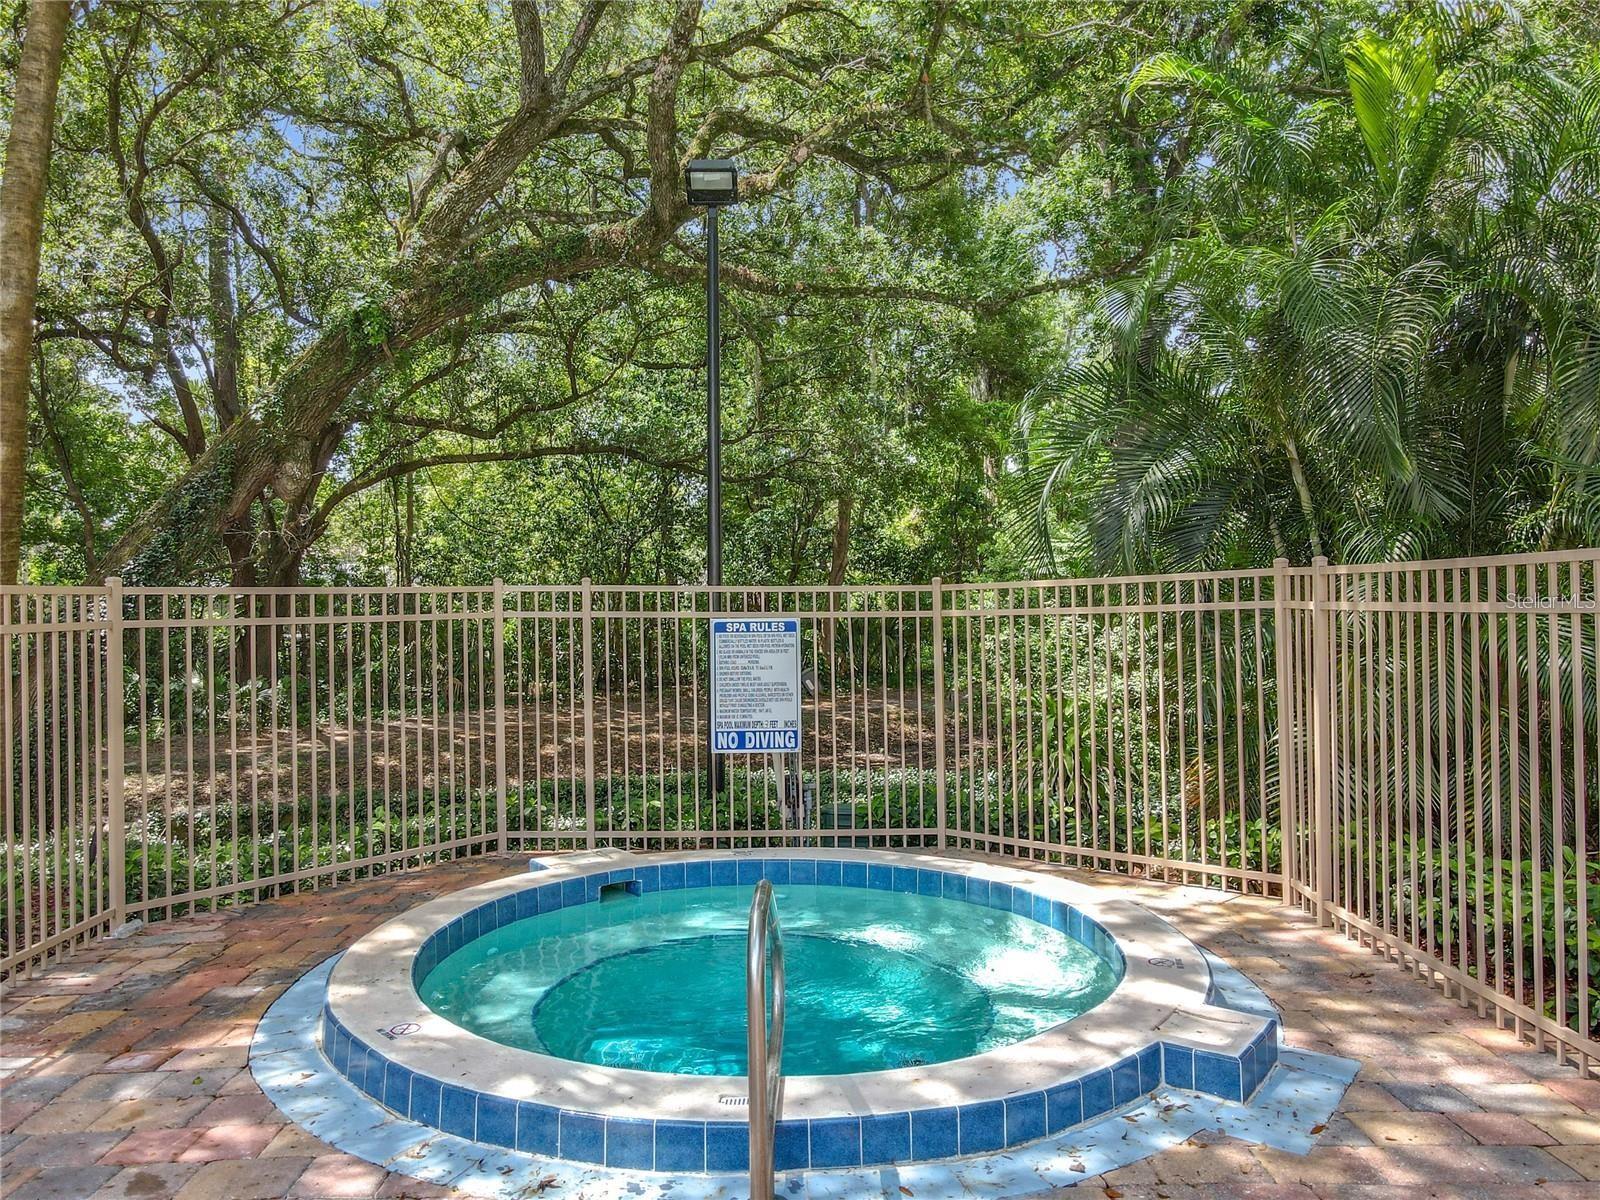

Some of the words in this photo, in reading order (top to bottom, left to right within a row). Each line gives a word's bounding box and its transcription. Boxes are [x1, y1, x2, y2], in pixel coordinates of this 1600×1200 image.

[726, 622, 747, 632] SPA
[750, 622, 785, 632] RULES
[717, 732, 739, 749] NO
[745, 731, 796, 749] DIVING
